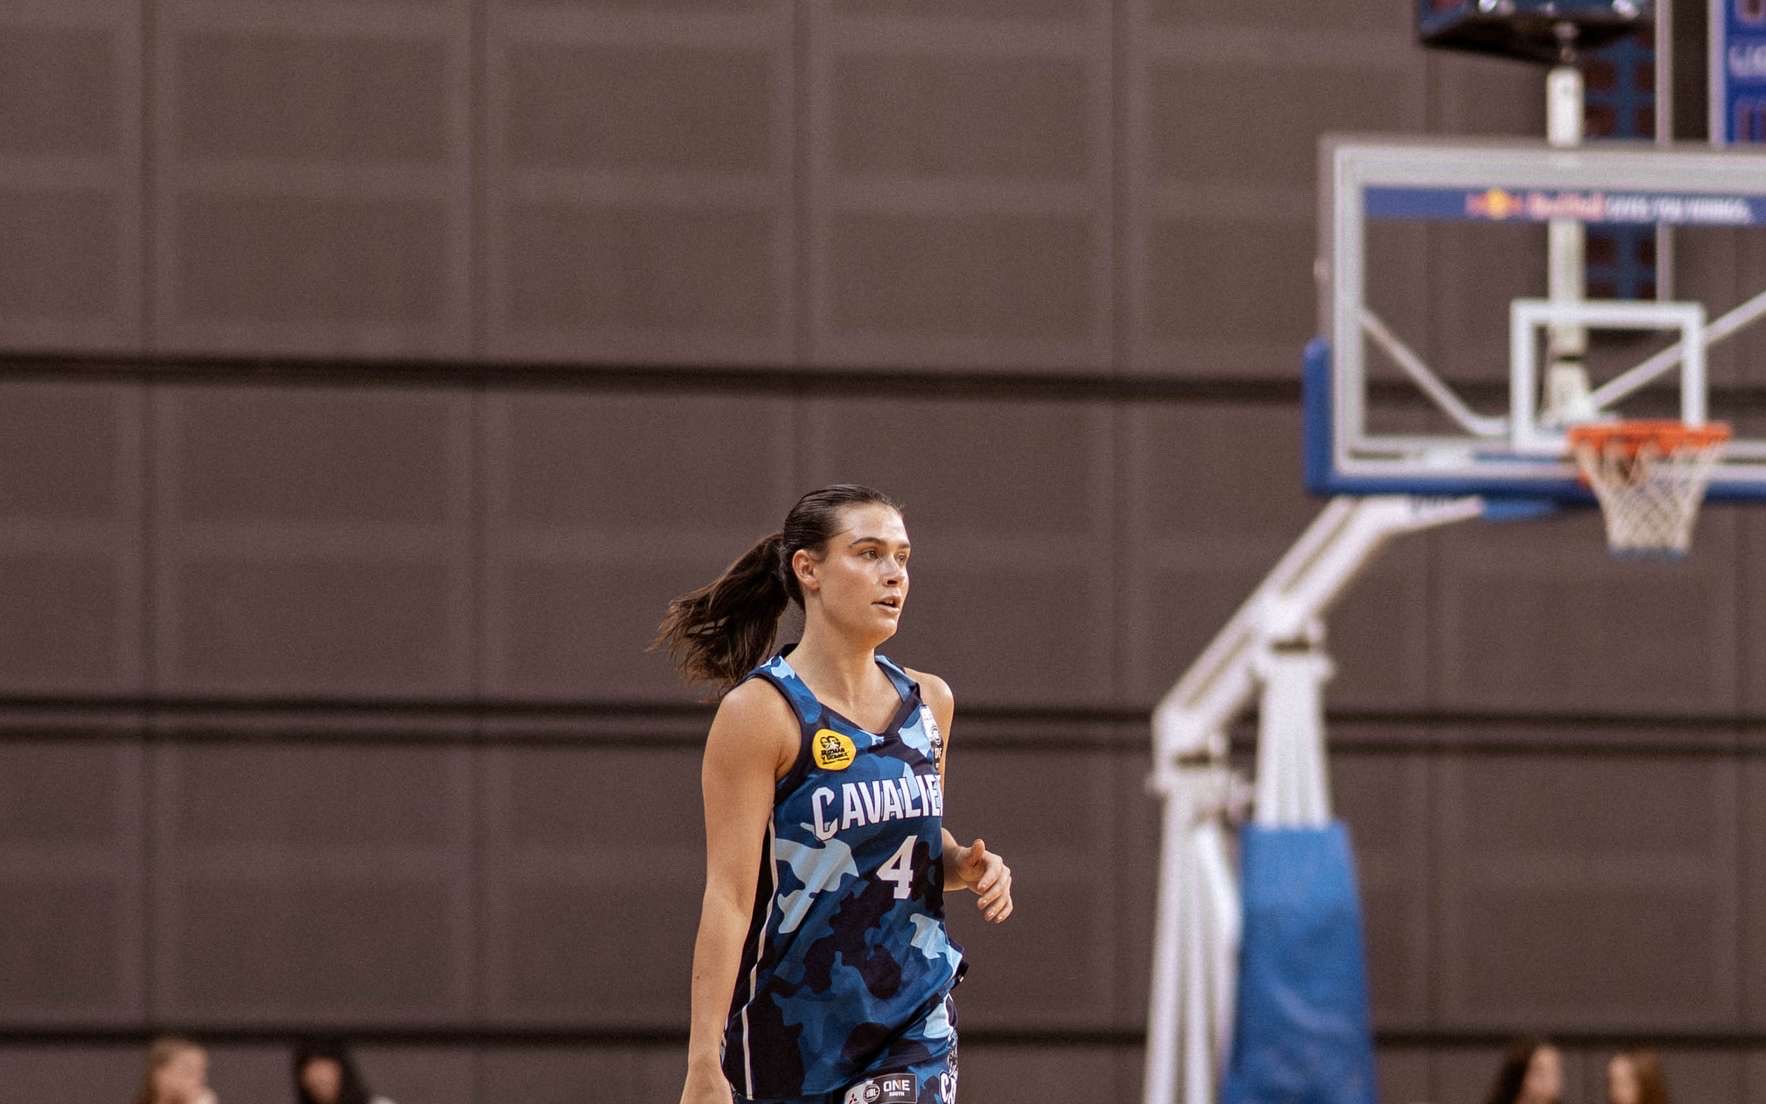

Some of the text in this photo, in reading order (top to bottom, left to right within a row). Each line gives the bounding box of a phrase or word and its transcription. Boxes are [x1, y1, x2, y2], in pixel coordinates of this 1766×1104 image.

[812, 774, 943, 841] CAVALIE
[876, 835, 919, 899] 4
[883, 1079, 911, 1092] ONE
